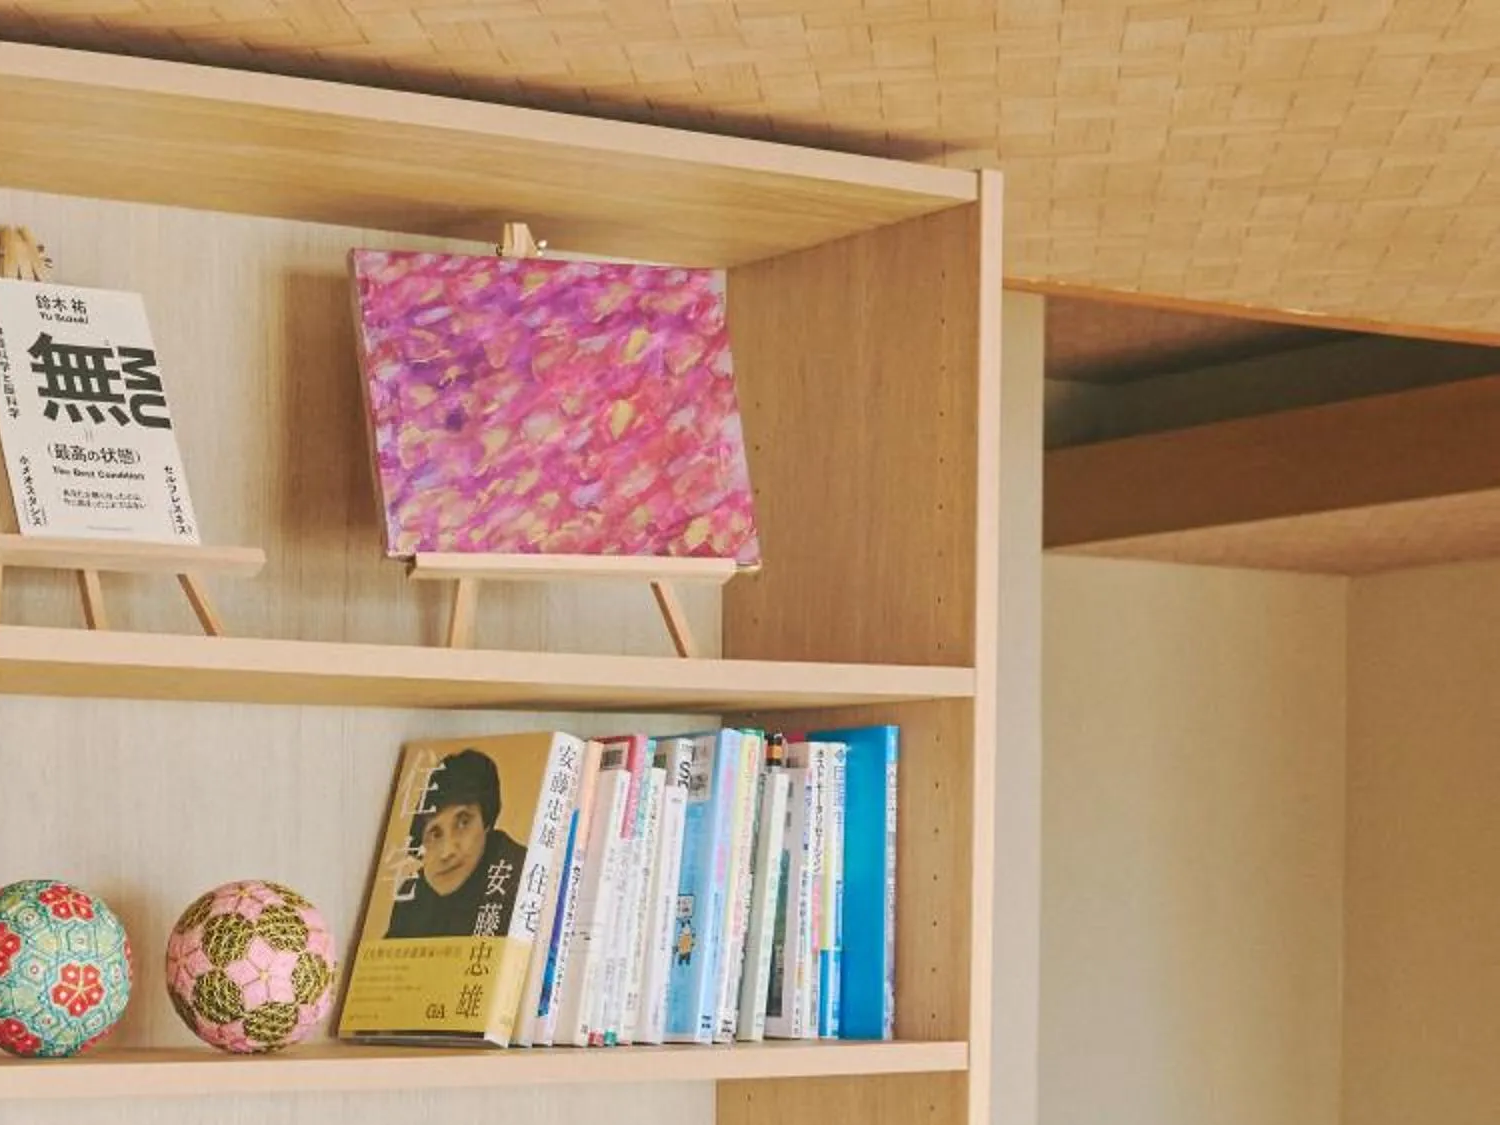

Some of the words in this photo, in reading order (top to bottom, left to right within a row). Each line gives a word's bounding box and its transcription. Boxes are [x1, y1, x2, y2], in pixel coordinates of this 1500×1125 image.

[27, 331, 130, 427] 無
[117, 345, 173, 430] MU
[455, 858, 514, 1019] 安藤忠雄
